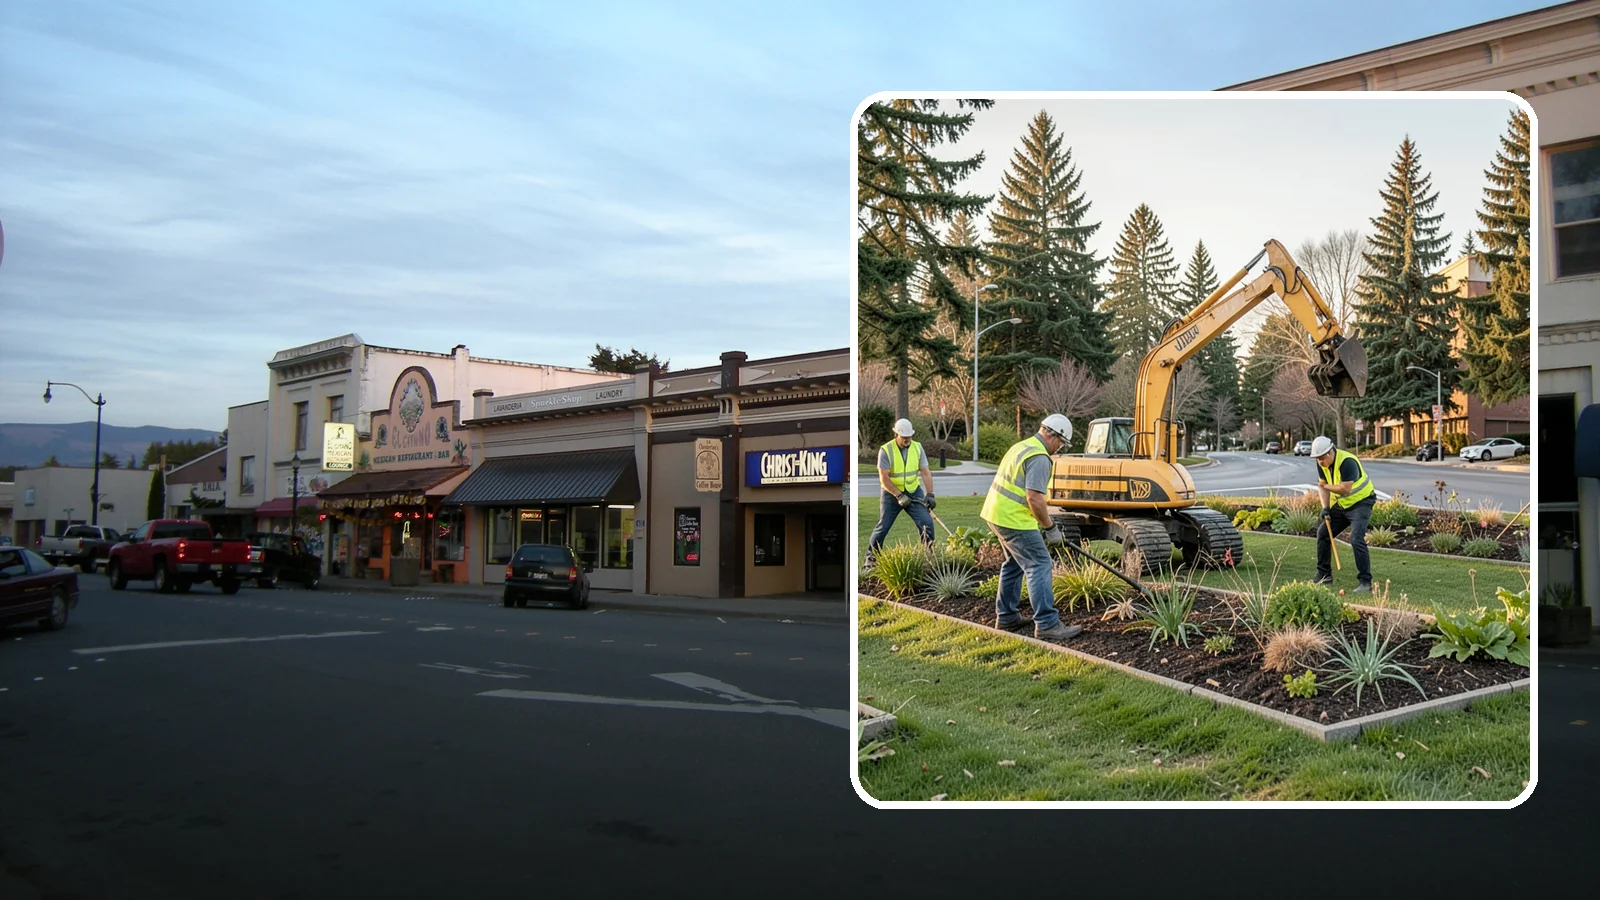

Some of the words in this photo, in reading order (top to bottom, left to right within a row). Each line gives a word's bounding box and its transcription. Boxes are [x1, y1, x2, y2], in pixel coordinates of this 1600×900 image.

[560, 394, 582, 404] Shop
[595, 389, 624, 400] LAUNDRY
[494, 402, 523, 413] LAVANDERIA
[373, 454, 396, 465] MEXICAN
[397, 451, 434, 463] RESTAURANT
[437, 450, 450, 459] BAR
[799, 450, 827, 477] KING
